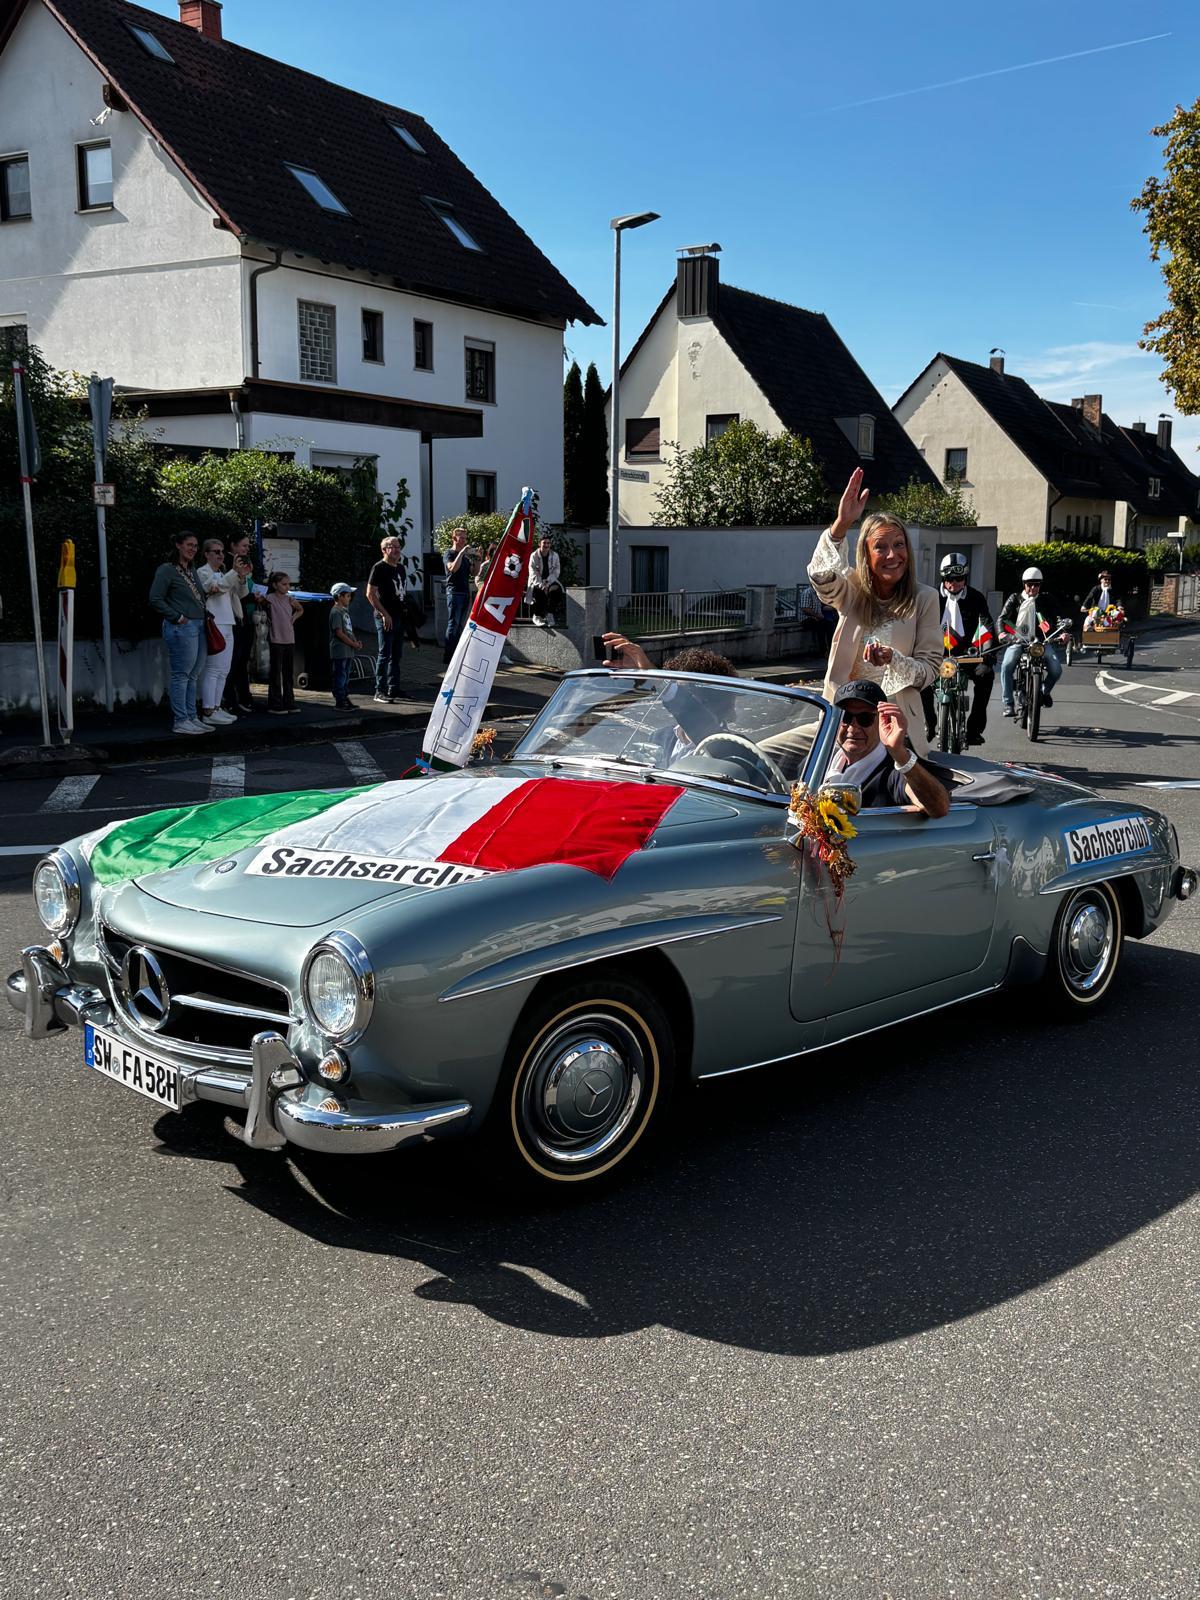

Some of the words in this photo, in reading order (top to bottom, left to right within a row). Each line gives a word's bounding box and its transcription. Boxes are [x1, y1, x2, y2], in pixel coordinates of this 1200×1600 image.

[1069, 816, 1150, 864] Sachserclub
[261, 847, 491, 888] Sachserclu
[94, 1034, 112, 1073] SW
[122, 1049, 143, 1089] FA
[145, 1060, 178, 1105] 58H
